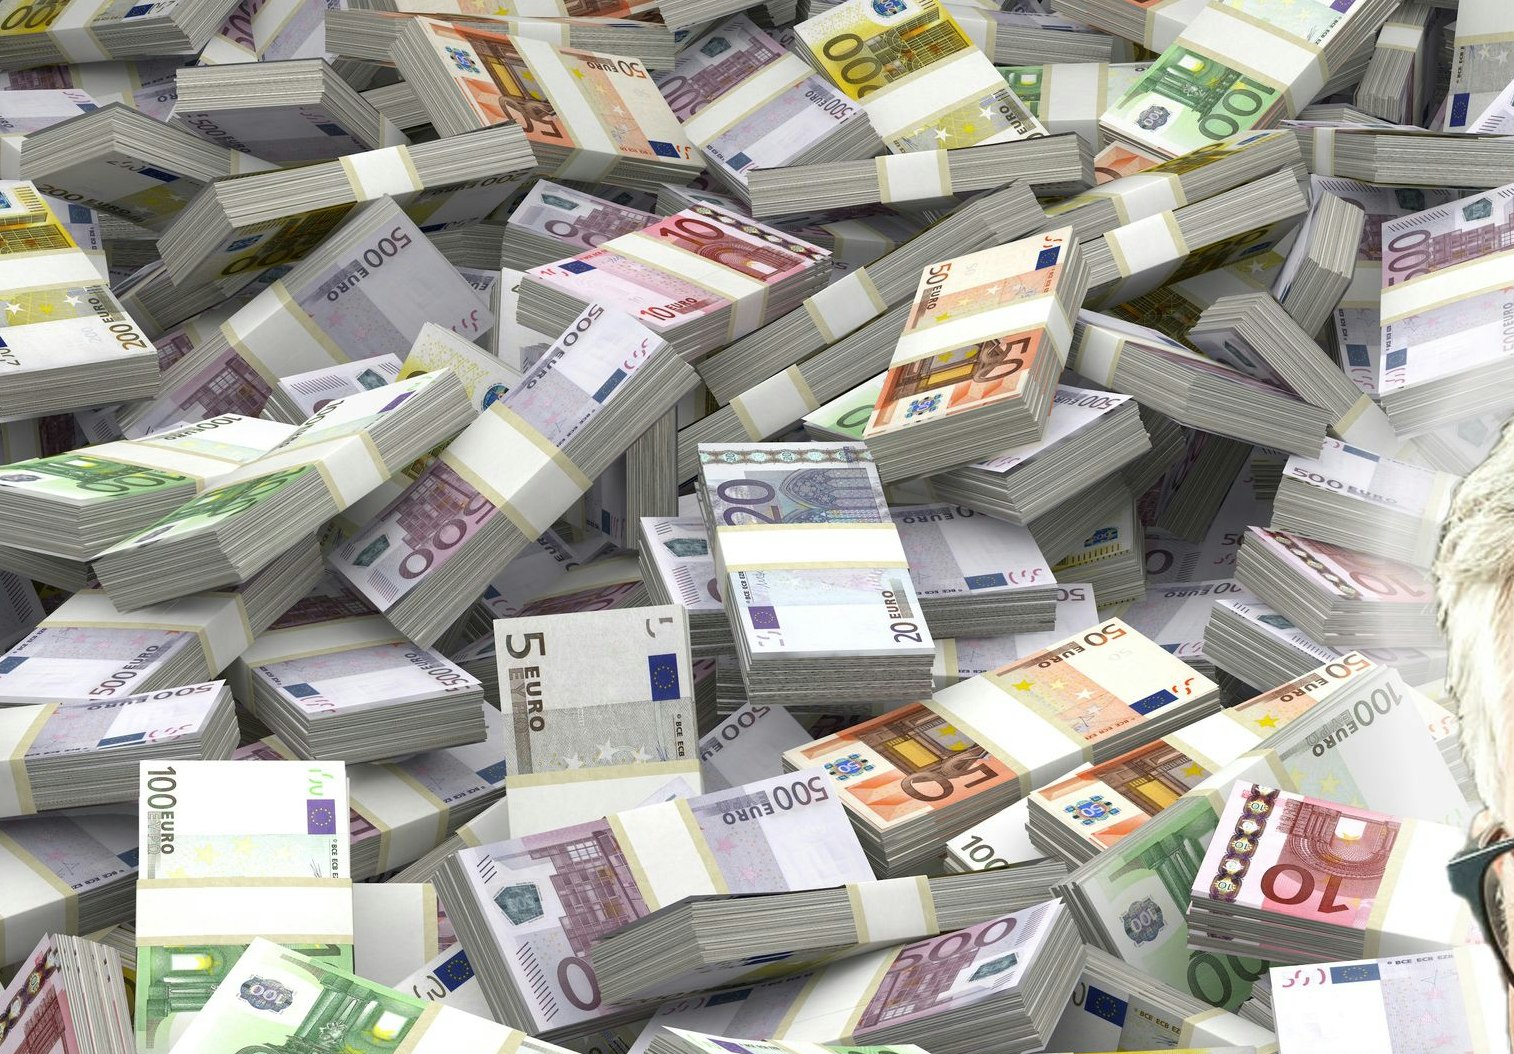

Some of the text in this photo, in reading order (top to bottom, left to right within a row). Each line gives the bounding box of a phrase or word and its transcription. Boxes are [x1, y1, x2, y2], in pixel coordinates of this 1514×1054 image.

[585, 57, 648, 80] 50 EURO
[804, 89, 859, 124] 500 EURO
[1000, 106, 1028, 135] EURO
[1199, 79, 1277, 141] 100
[659, 219, 726, 243] 10
[326, 226, 413, 302] 500 EURO
[925, 263, 953, 311] 50 EURO
[88, 296, 147, 352] 200 EURO
[638, 297, 698, 322] 10 EURO
[1503, 302, 1514, 325] EURO
[525, 305, 605, 390] 500 EURO
[972, 335, 1032, 384] 50
[164, 414, 242, 441] 100 EURO
[1293, 467, 1399, 504] 500 EURO
[903, 509, 955, 524] EURO
[888, 590, 922, 644] 20 EURO
[1038, 622, 1127, 669] 50 EURO
[89, 644, 159, 701] 500 EURO
[404, 652, 469, 693] 500 EURO
[506, 632, 546, 732] 5 EURO
[1279, 653, 1372, 704] 50 EURO
[87, 682, 213, 711] 500 EURO
[675, 720, 686, 758] BCE ECB
[720, 703, 770, 741] 500
[1312, 681, 1403, 757] 100 EURO
[837, 761, 857, 773] 50
[901, 751, 999, 801] 50
[146, 766, 178, 855] 100 EURO
[721, 776, 829, 827] 500 EURO
[1082, 802, 1105, 818] 50
[1259, 864, 1350, 917] 10
[1131, 908, 1158, 932] 100
[249, 982, 287, 1003] 100
